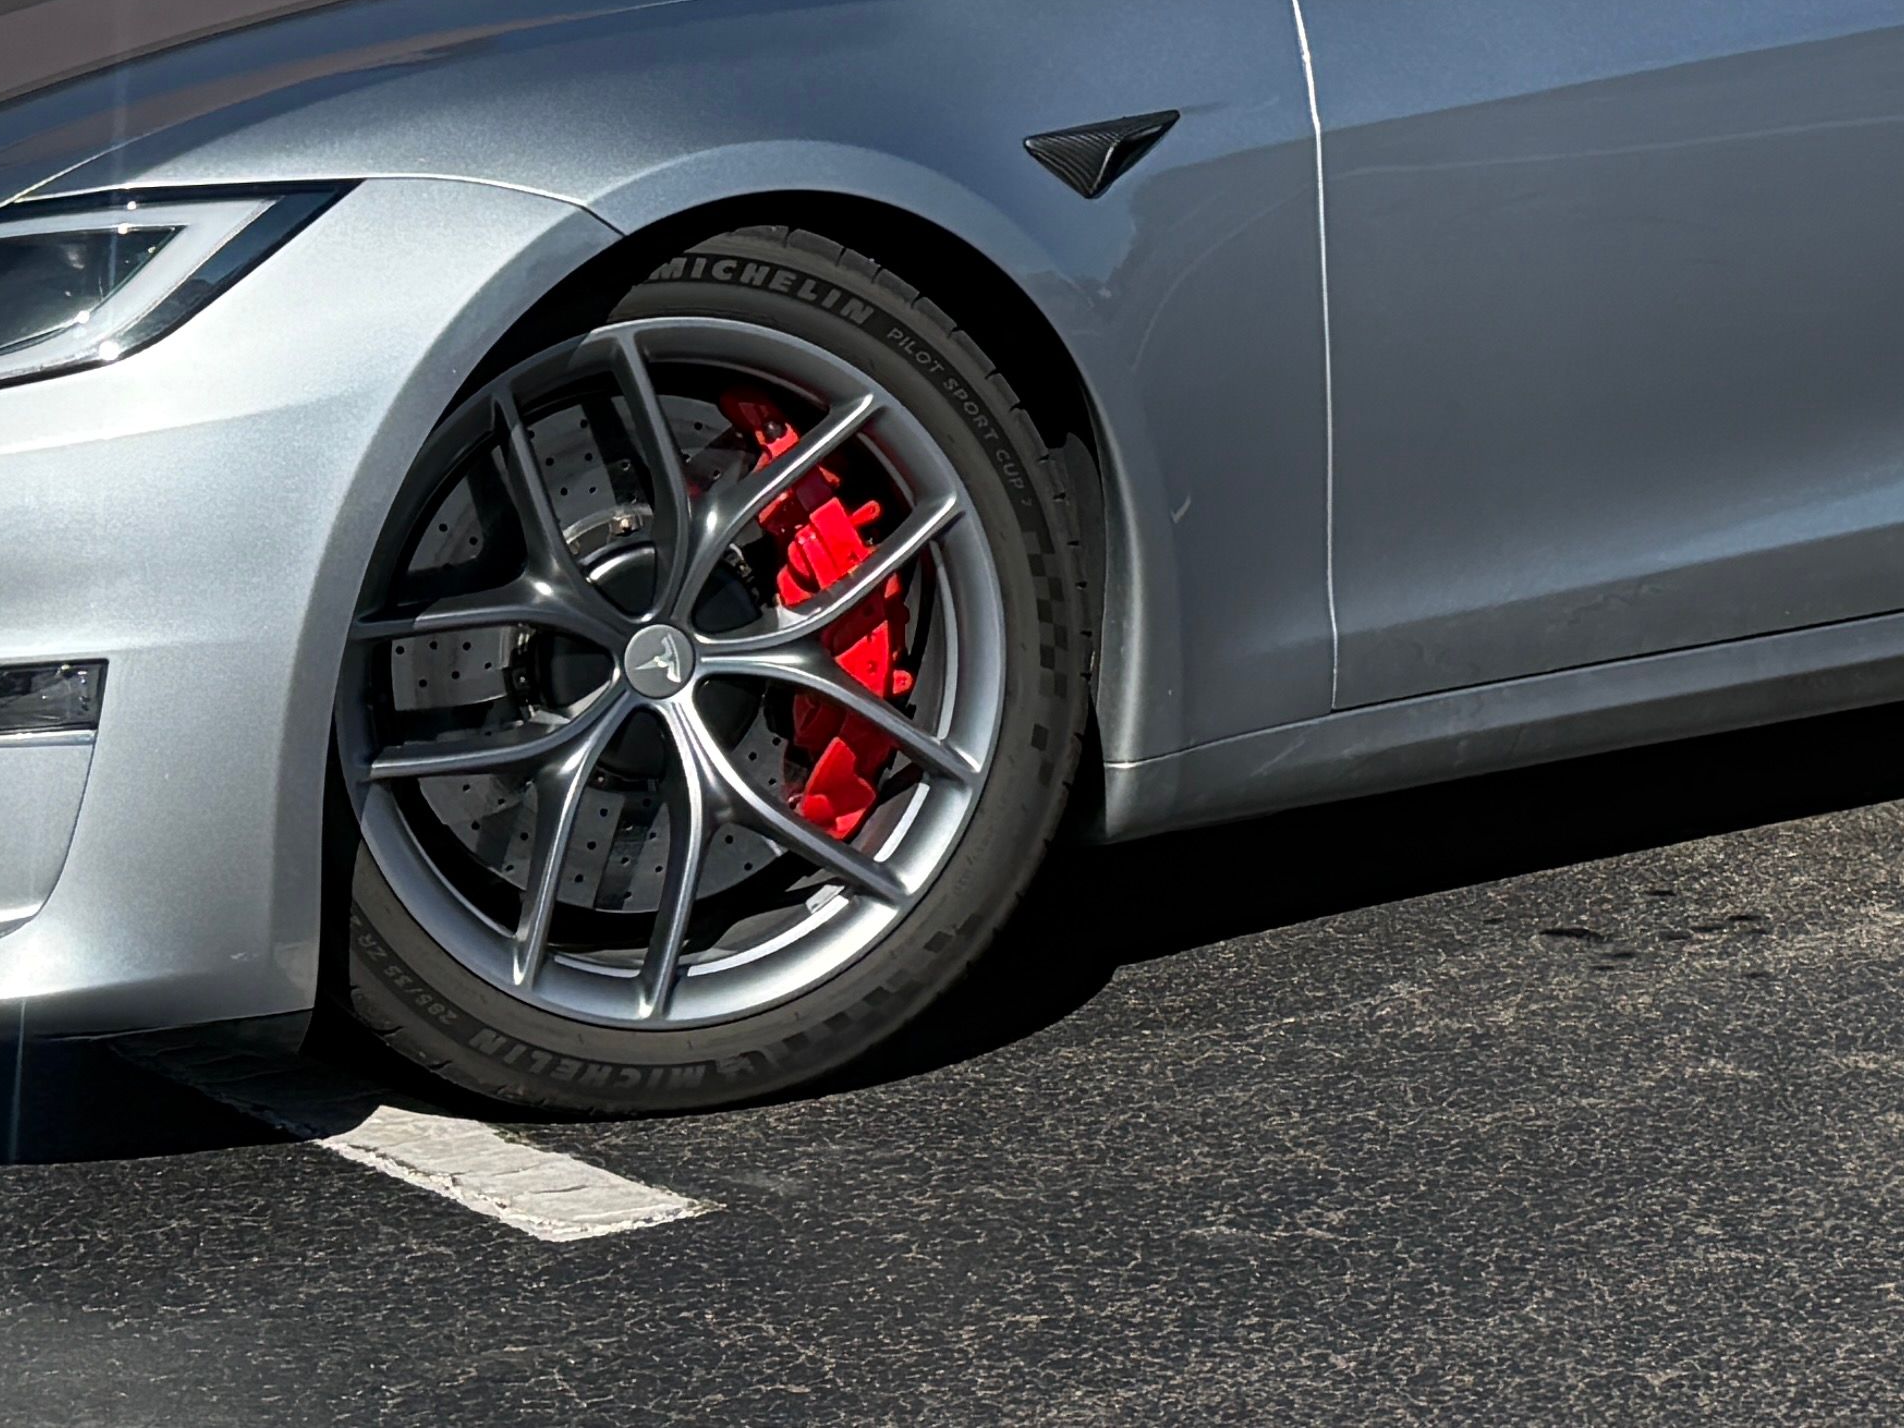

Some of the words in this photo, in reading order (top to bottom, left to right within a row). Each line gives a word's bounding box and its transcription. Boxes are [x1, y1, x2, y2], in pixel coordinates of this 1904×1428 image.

[649, 256, 874, 325] MICHELIN
[886, 327, 945, 373] PILOT
[943, 377, 1000, 442] SPORT
[995, 449, 1025, 489] CUP
[468, 1027, 707, 1091] MICHELIN
